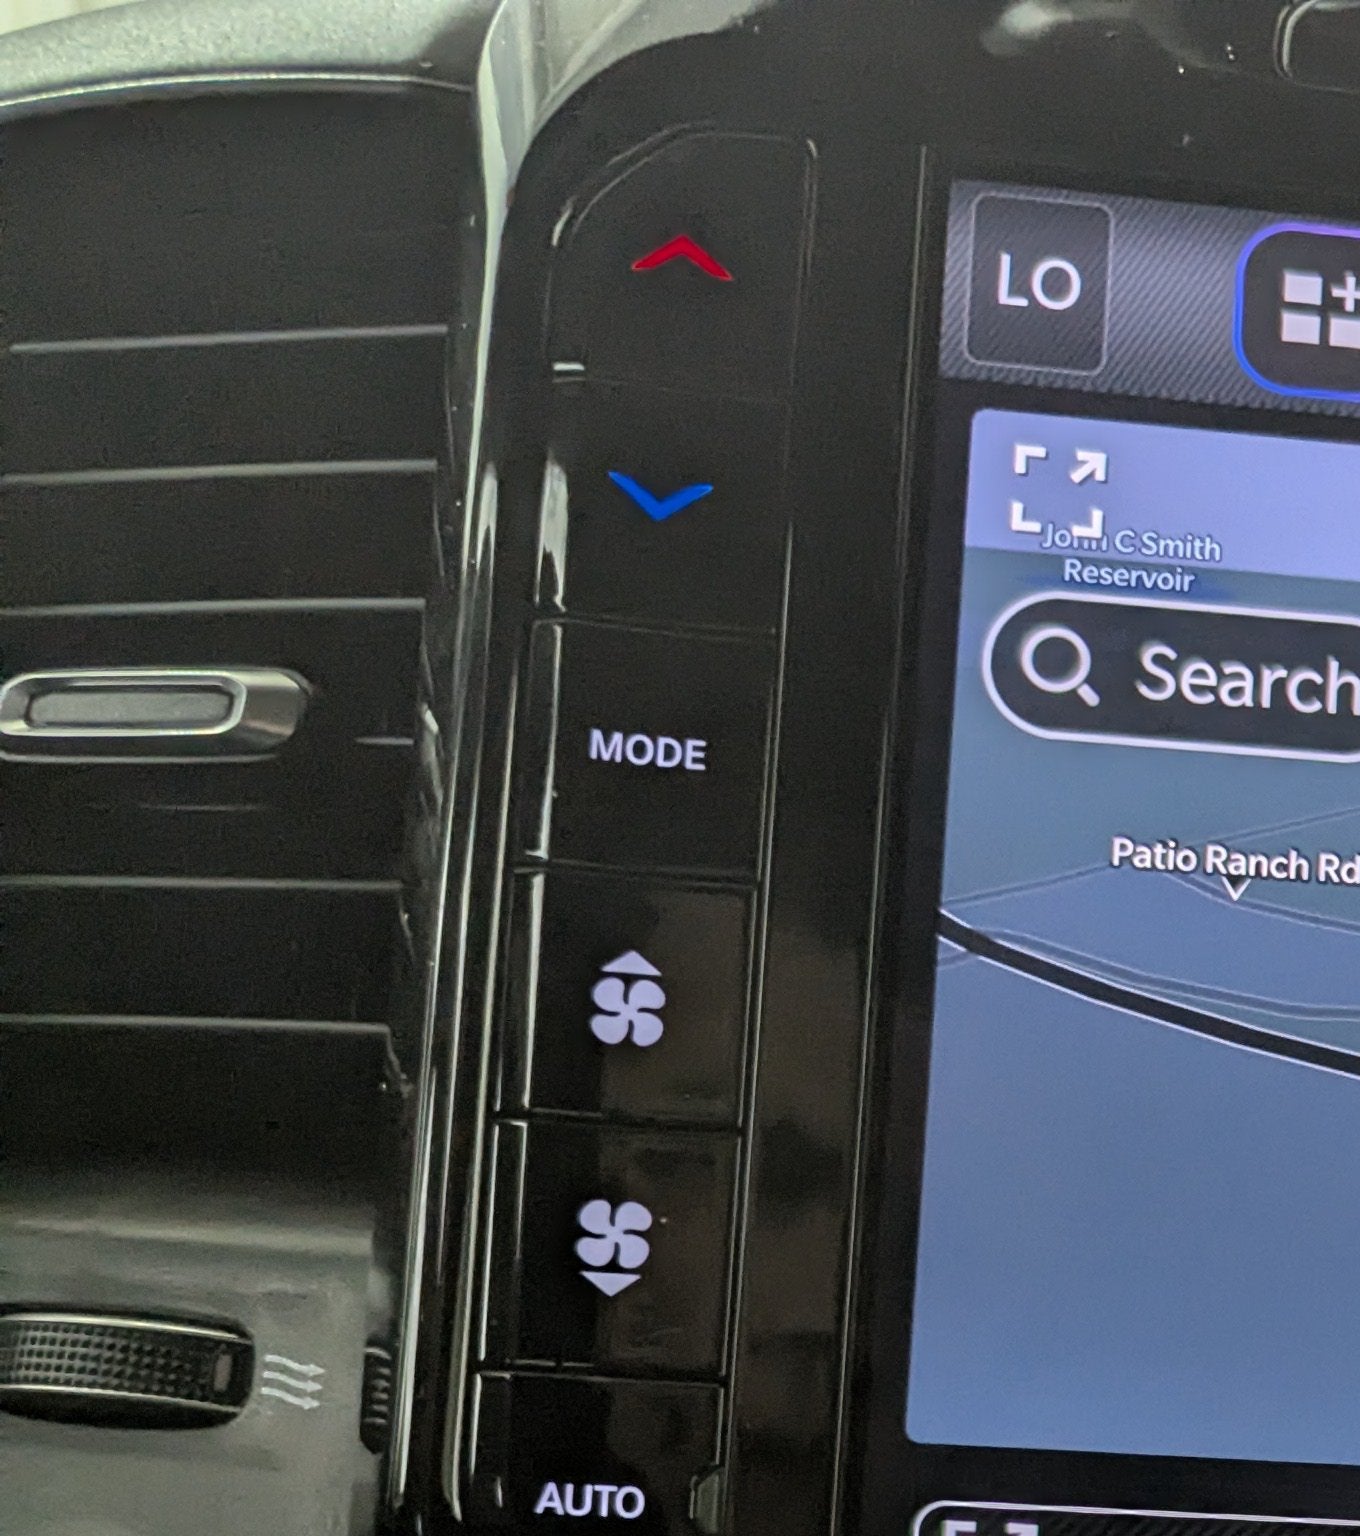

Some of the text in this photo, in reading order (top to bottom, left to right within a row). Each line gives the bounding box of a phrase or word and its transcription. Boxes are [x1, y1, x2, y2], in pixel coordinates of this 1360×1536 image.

[998, 253, 1081, 311] LO
[1114, 529, 1135, 553] C
[1141, 532, 1221, 561] Smith
[1063, 557, 1196, 592] Reservoir
[590, 729, 707, 771] MODE
[1112, 837, 1197, 872] Patio
[1205, 844, 1309, 881] Ranch
[535, 1481, 646, 1519] AUTO
